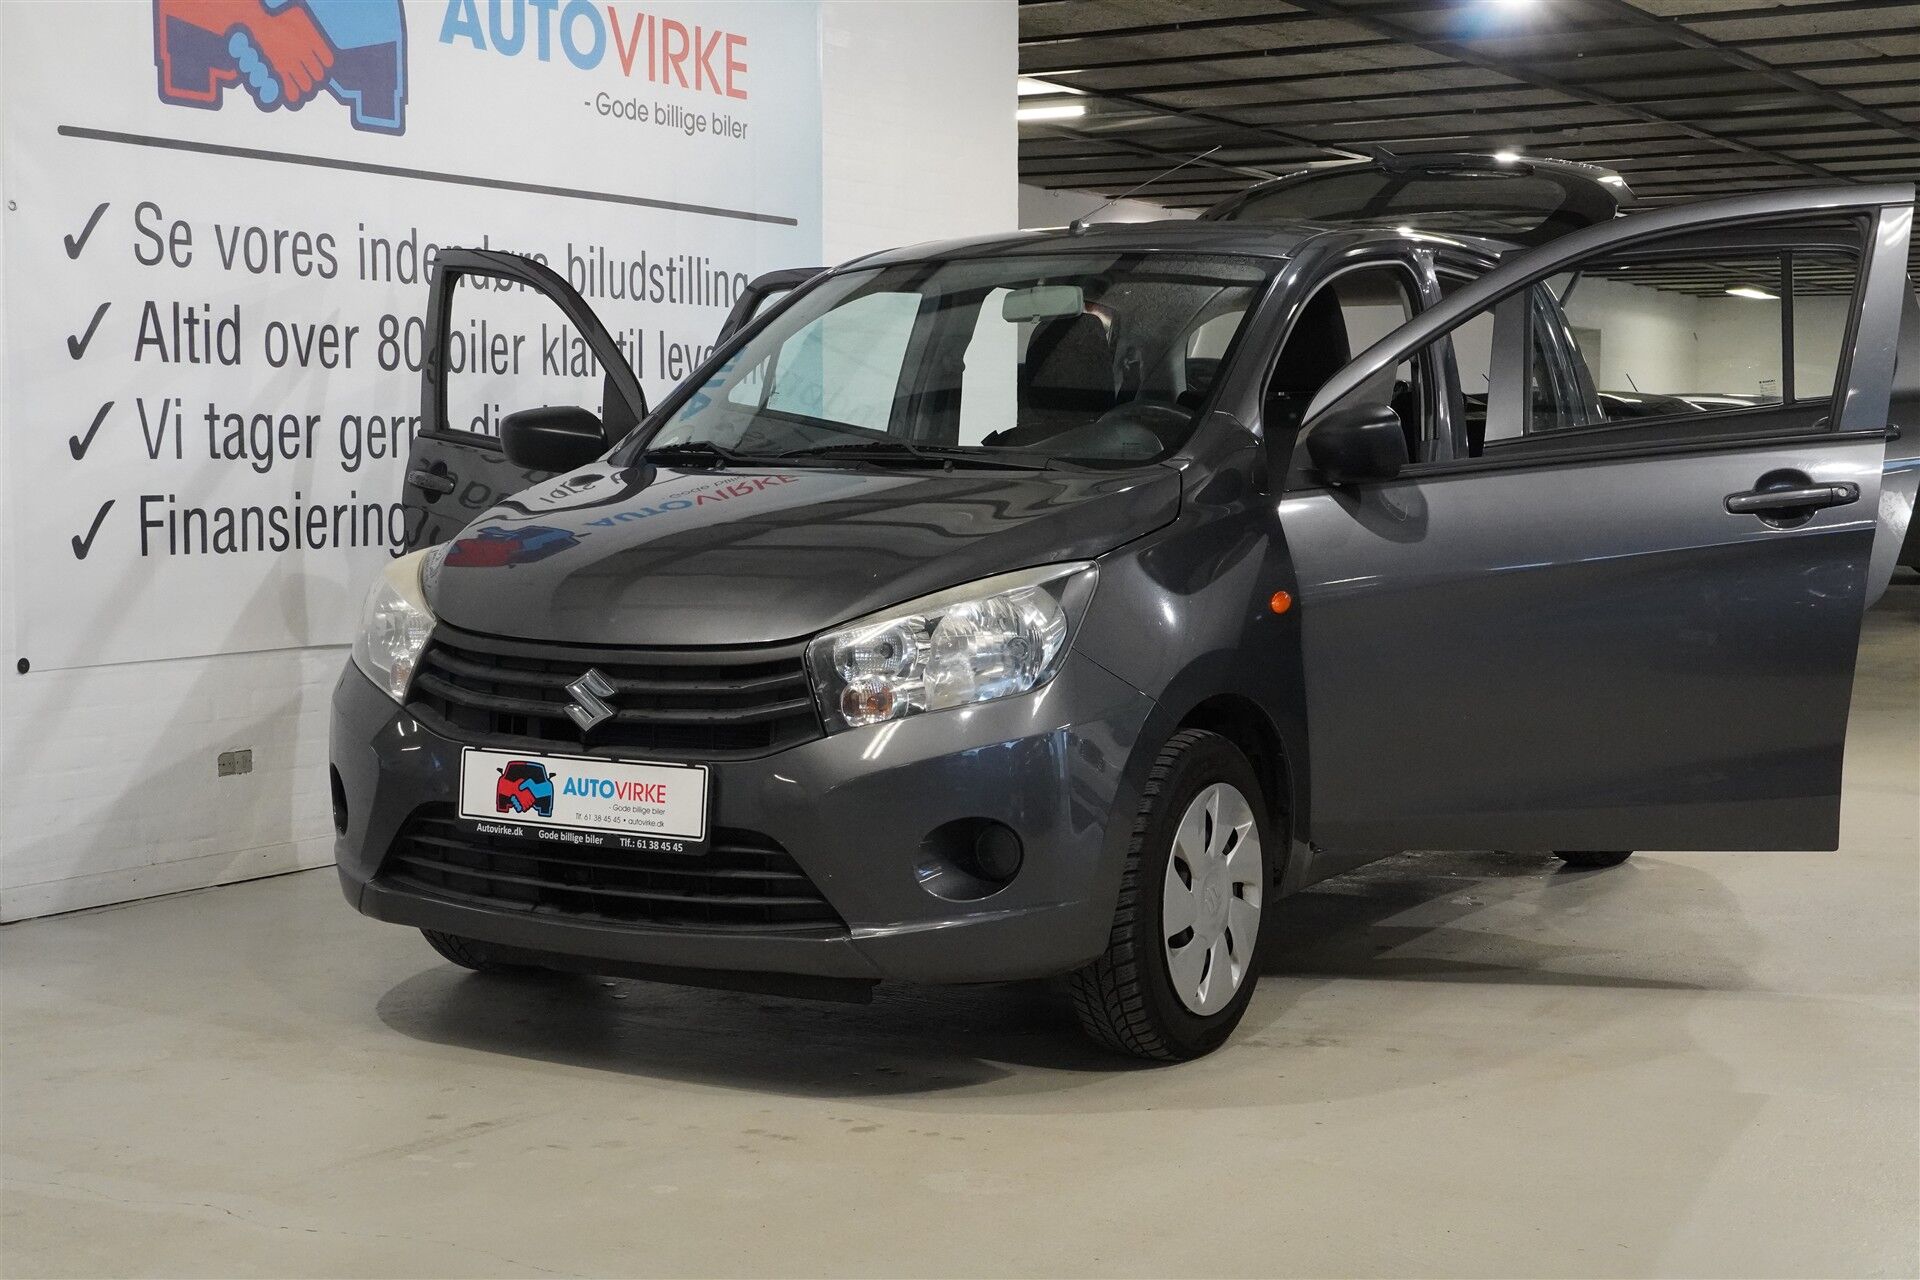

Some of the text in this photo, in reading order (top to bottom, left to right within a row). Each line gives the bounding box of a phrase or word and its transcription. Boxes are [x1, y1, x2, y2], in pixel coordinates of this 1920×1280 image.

[438, 0, 748, 100] AUTOVIRKE
[596, 92, 649, 123] Gode
[654, 102, 707, 136] billige
[712, 112, 748, 139] biler
[133, 201, 193, 268] Se
[214, 224, 339, 280] vores
[134, 300, 241, 366] Altid
[264, 320, 360, 369] over
[377, 314, 425, 372] 80
[136, 397, 183, 460] Vi
[204, 402, 321, 474] tager
[140, 491, 408, 559] Finansiering
[563, 776, 667, 804] AUTOVIRKE
[612, 804, 631, 813] Gode
[632, 805, 651, 816] billige
[652, 807, 666, 816] biler
[476, 823, 684, 852] Autovirke.dk Gode billige biler Tlf.: 61 38 45 45
[584, 813, 592, 821] 61
[594, 814, 602, 822] 38
[603, 815, 612, 823] 45
[613, 816, 621, 824] 45
[627, 818, 665, 828] autovirke.dk
